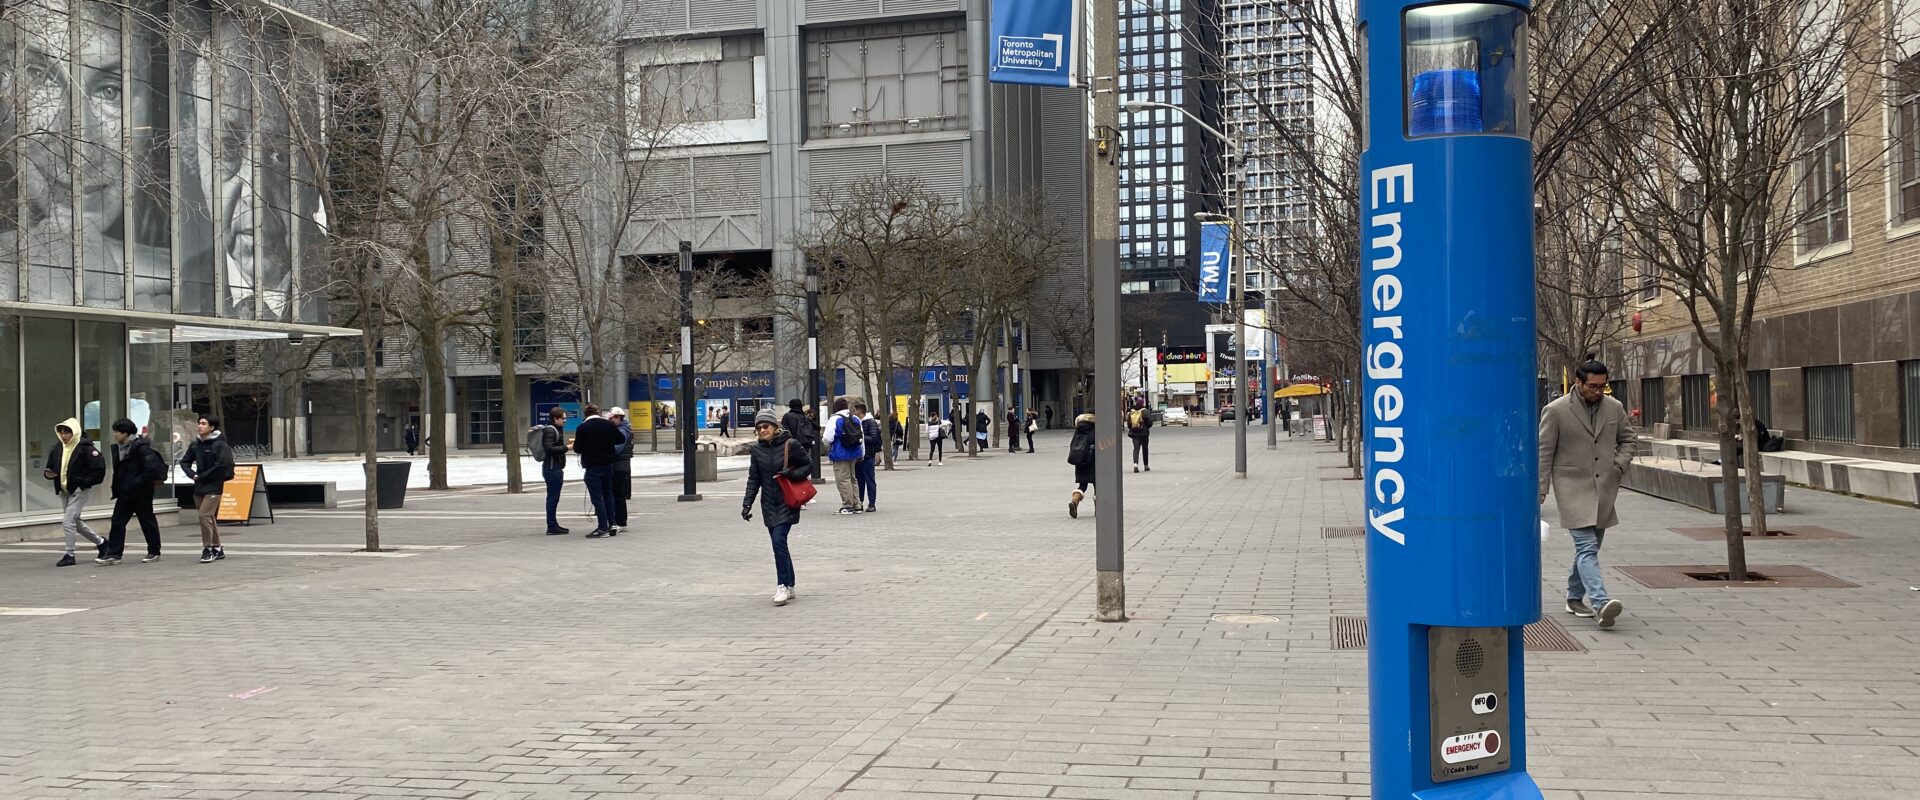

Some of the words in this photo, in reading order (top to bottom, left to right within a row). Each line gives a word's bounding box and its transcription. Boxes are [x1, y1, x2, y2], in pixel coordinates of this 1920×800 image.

[1002, 39, 1034, 48] Toronto
[1002, 48, 1054, 58] Metropolitan
[1002, 56, 1043, 66] University
[1202, 252, 1220, 296] TMU
[1366, 163, 1414, 546] Emergency
[694, 377, 739, 390] Cmpus
[1474, 697, 1486, 706] INFO
[1446, 742, 1480, 755] EMERGENCY
